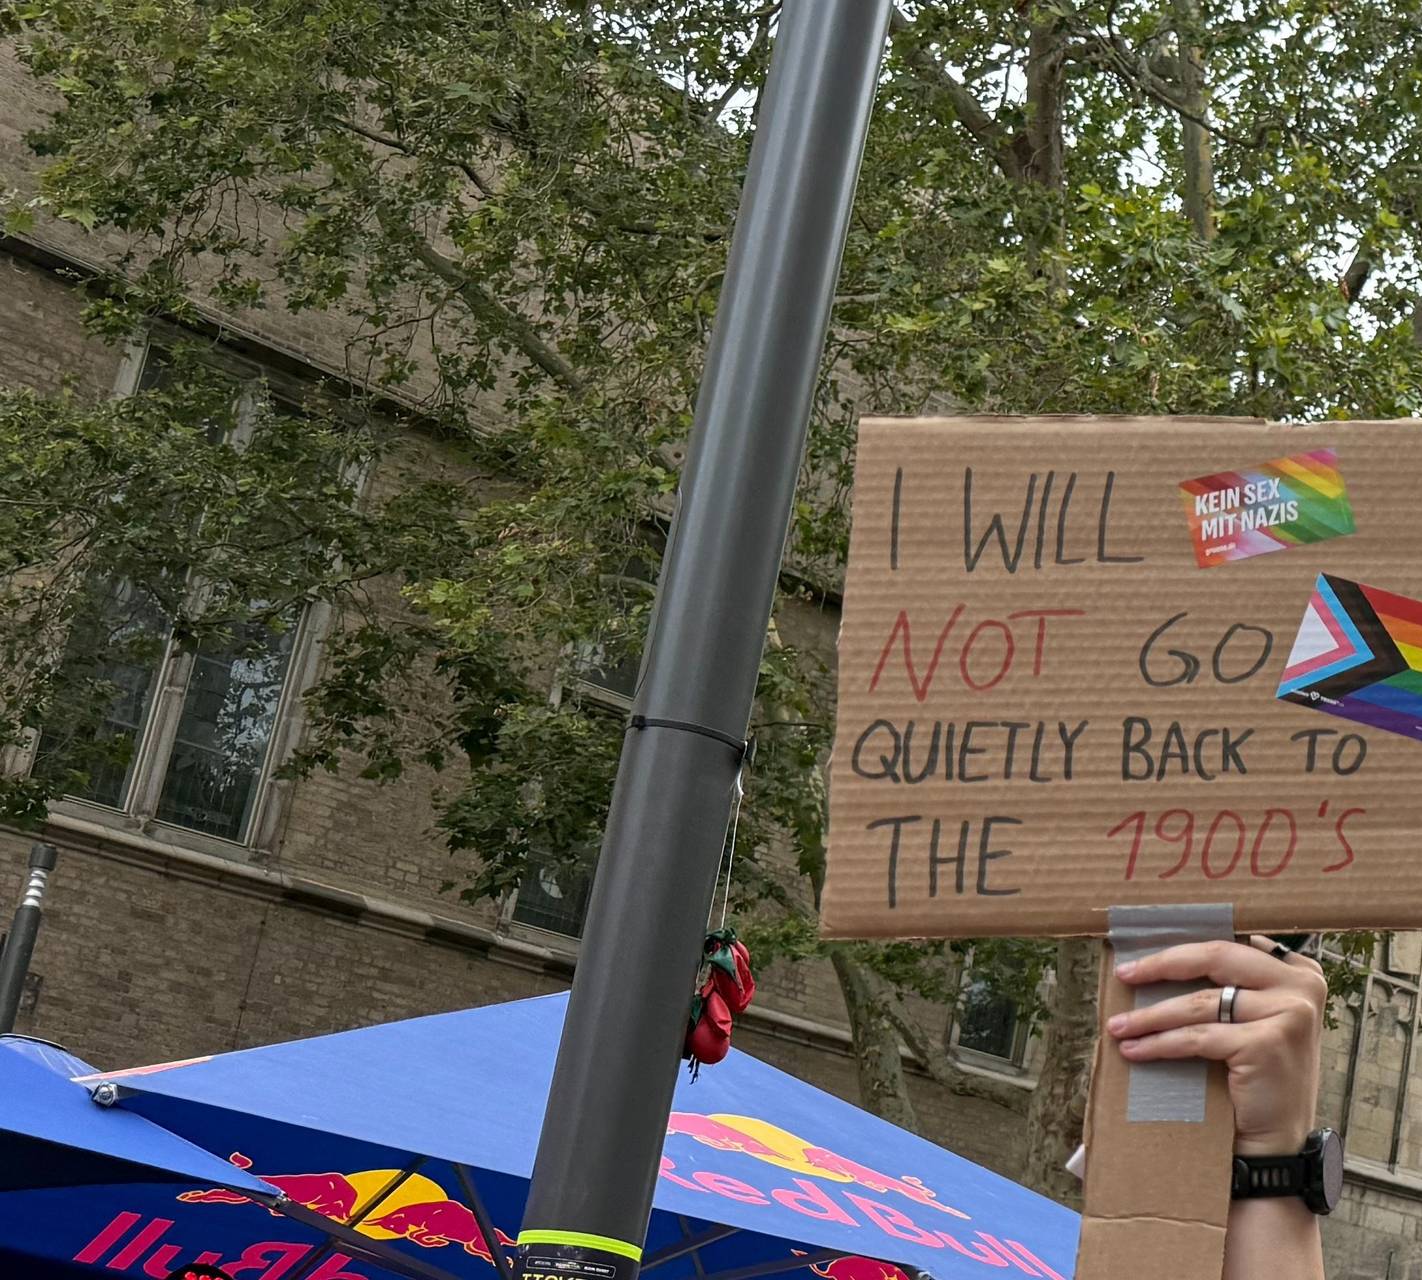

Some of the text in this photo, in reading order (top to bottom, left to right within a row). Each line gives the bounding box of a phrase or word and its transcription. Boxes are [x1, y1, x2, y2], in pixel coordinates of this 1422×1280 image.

[892, 467, 1144, 573] I WILL
[1195, 477, 1281, 516] KEIN SEX
[1201, 500, 1299, 541] MIT NAZIS
[868, 603, 1273, 702] NOT GO
[851, 716, 1368, 784] QUIETLY BACK TO
[866, 814, 1023, 909] THE
